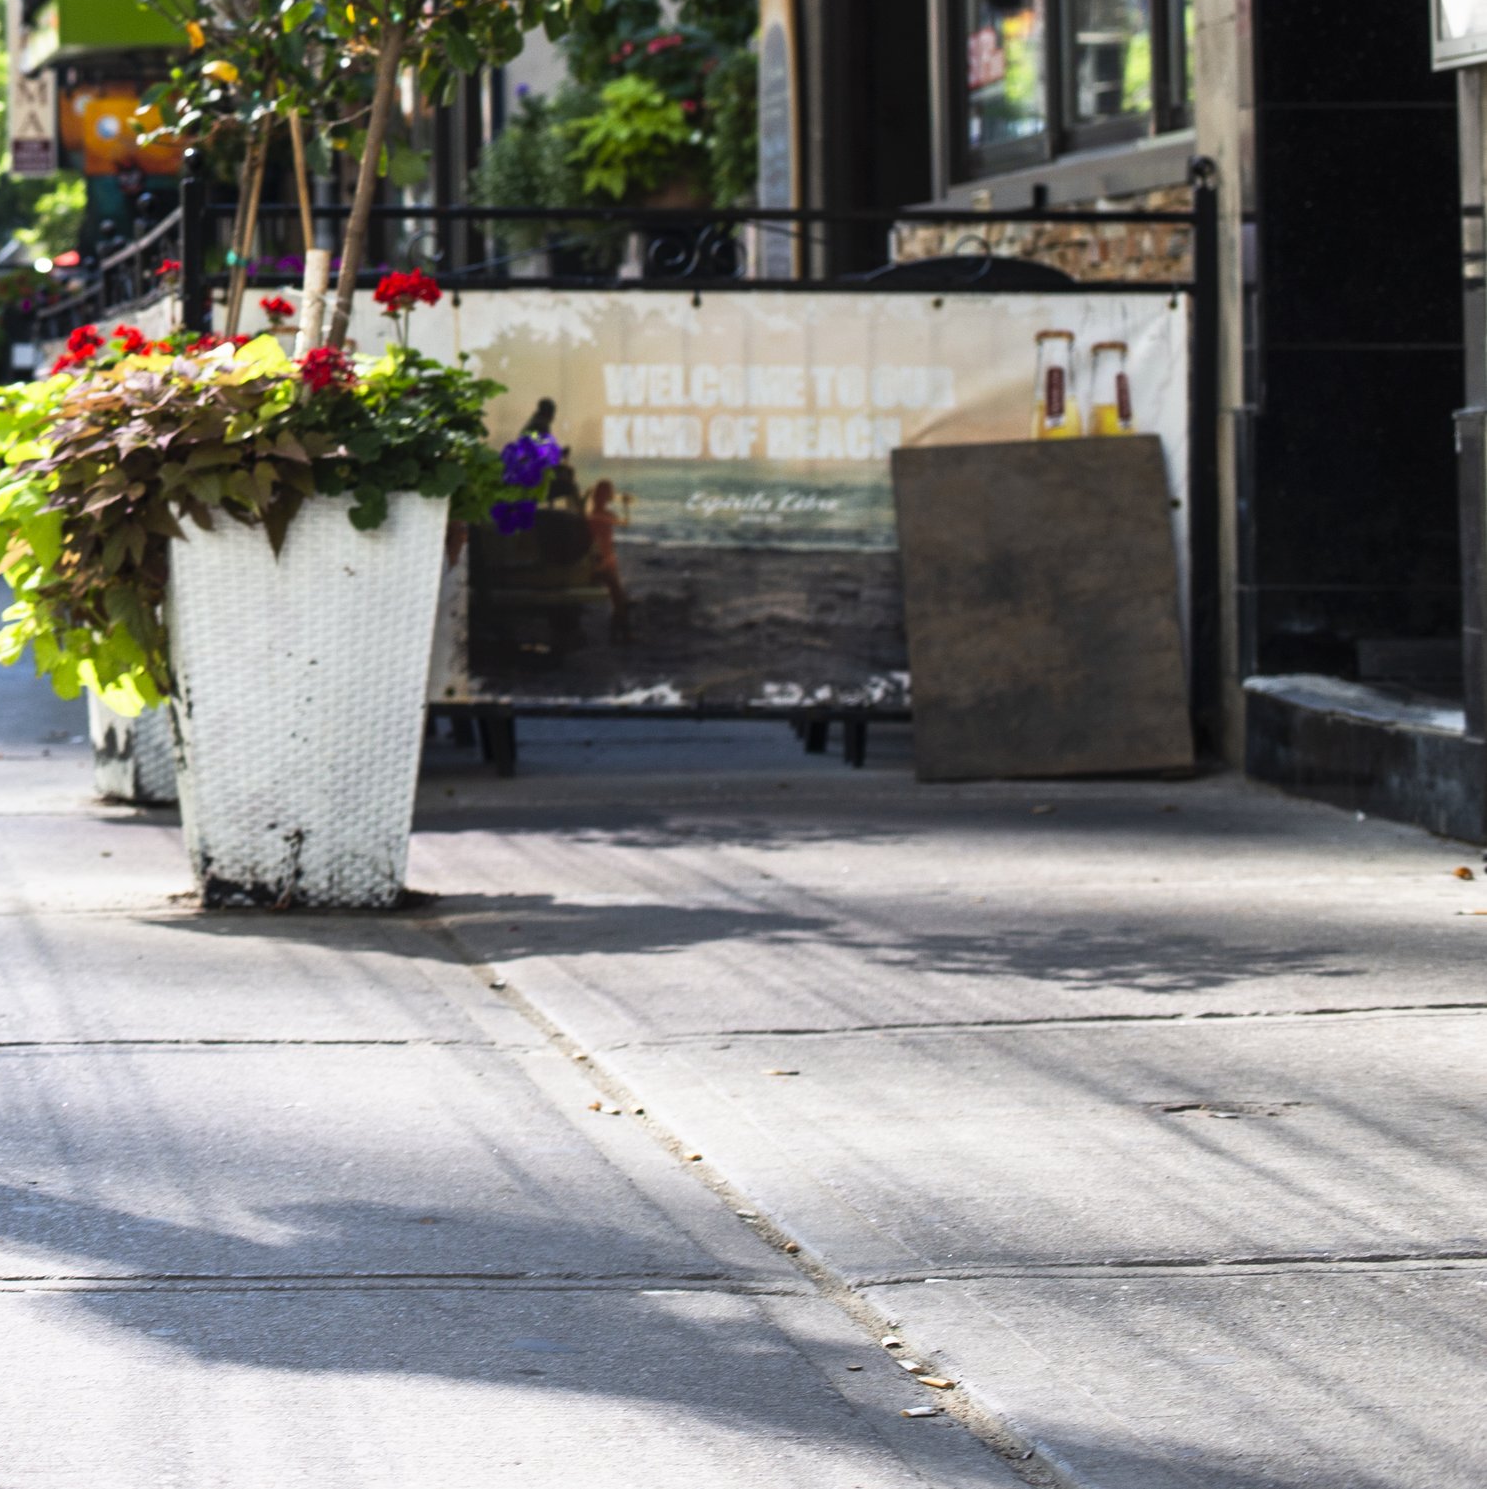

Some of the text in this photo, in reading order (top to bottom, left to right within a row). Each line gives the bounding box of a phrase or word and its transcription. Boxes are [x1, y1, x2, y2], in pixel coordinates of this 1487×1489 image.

[602, 364, 955, 408] WELCOME TO OUR
[602, 414, 703, 458] KIND
[708, 415, 759, 458] OF
